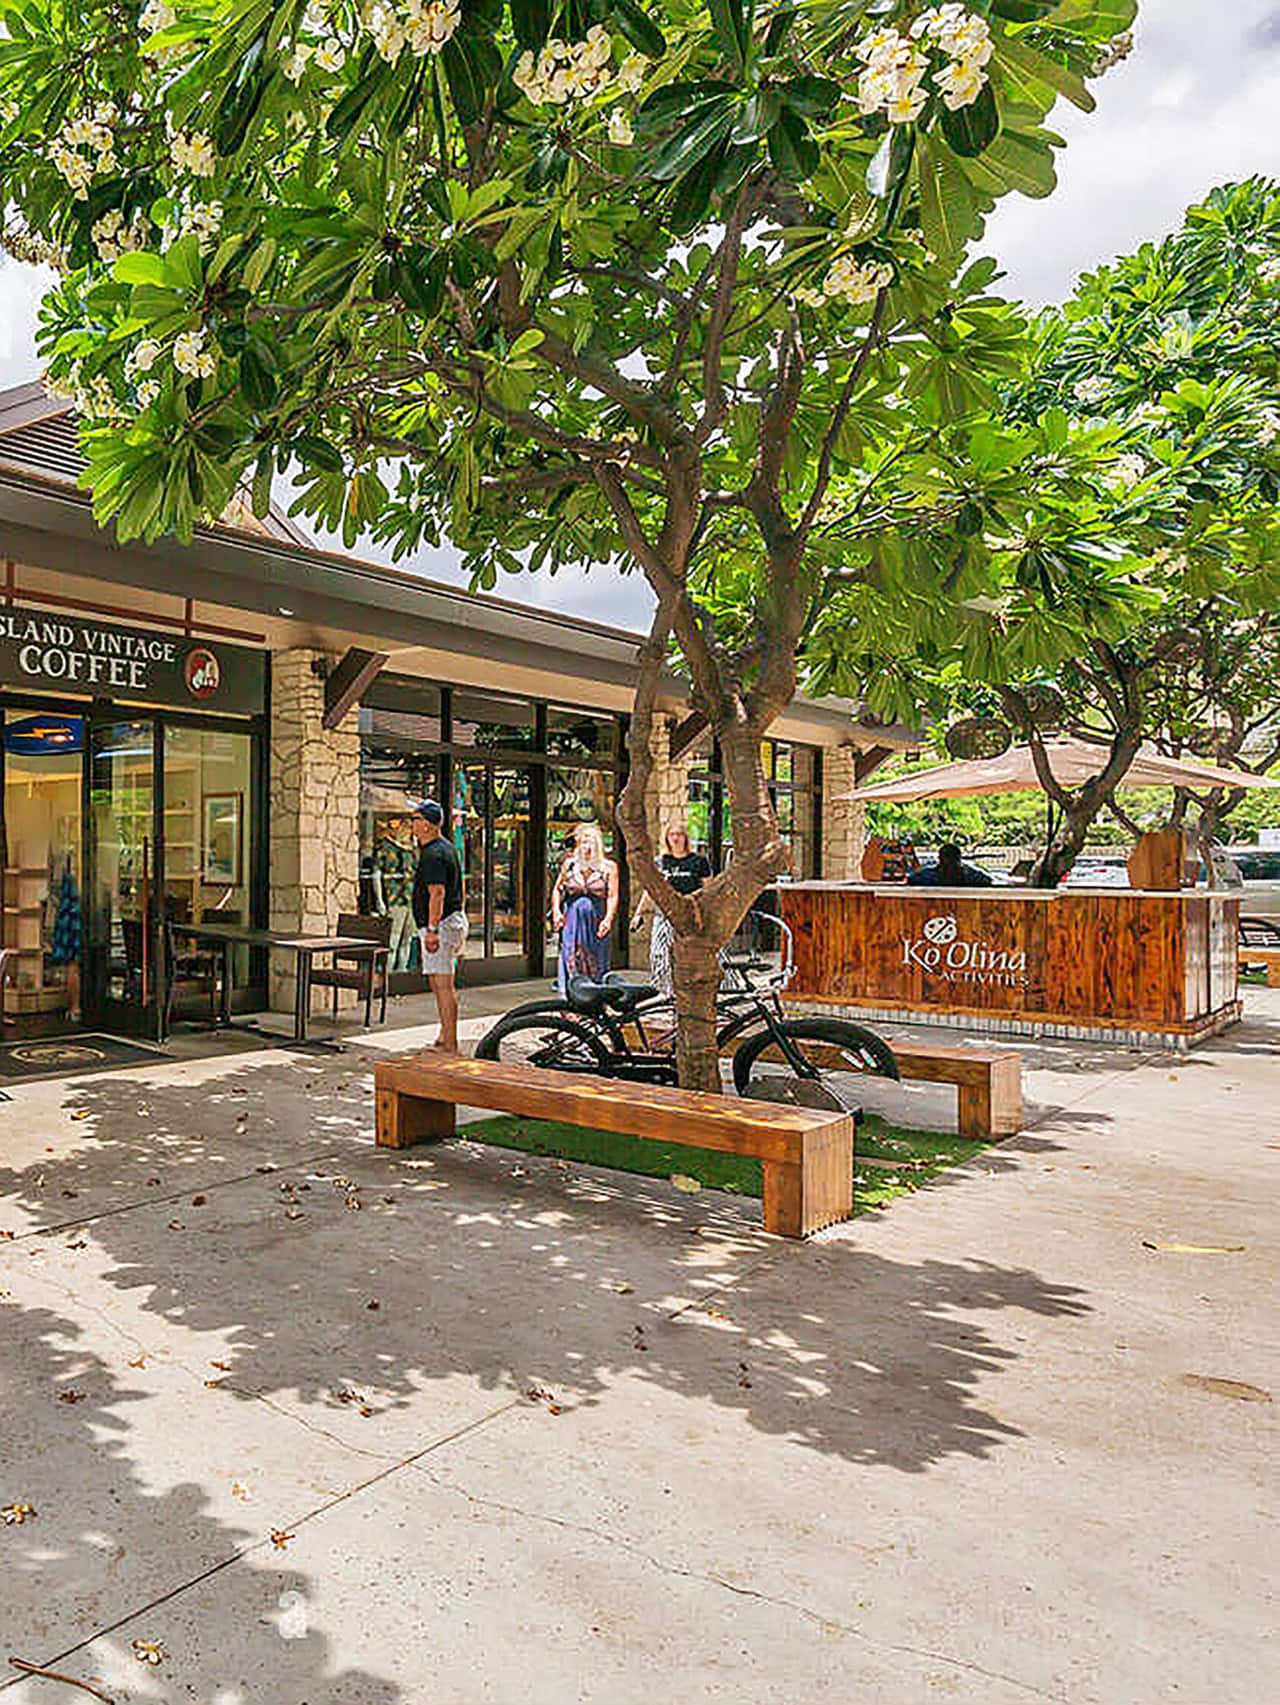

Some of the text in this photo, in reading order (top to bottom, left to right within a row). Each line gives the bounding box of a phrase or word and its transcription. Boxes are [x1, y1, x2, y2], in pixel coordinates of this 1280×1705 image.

[83, 629, 176, 663] VINTAGE
[19, 645, 148, 689] COFFEE
[946, 941, 1027, 971] Olina
